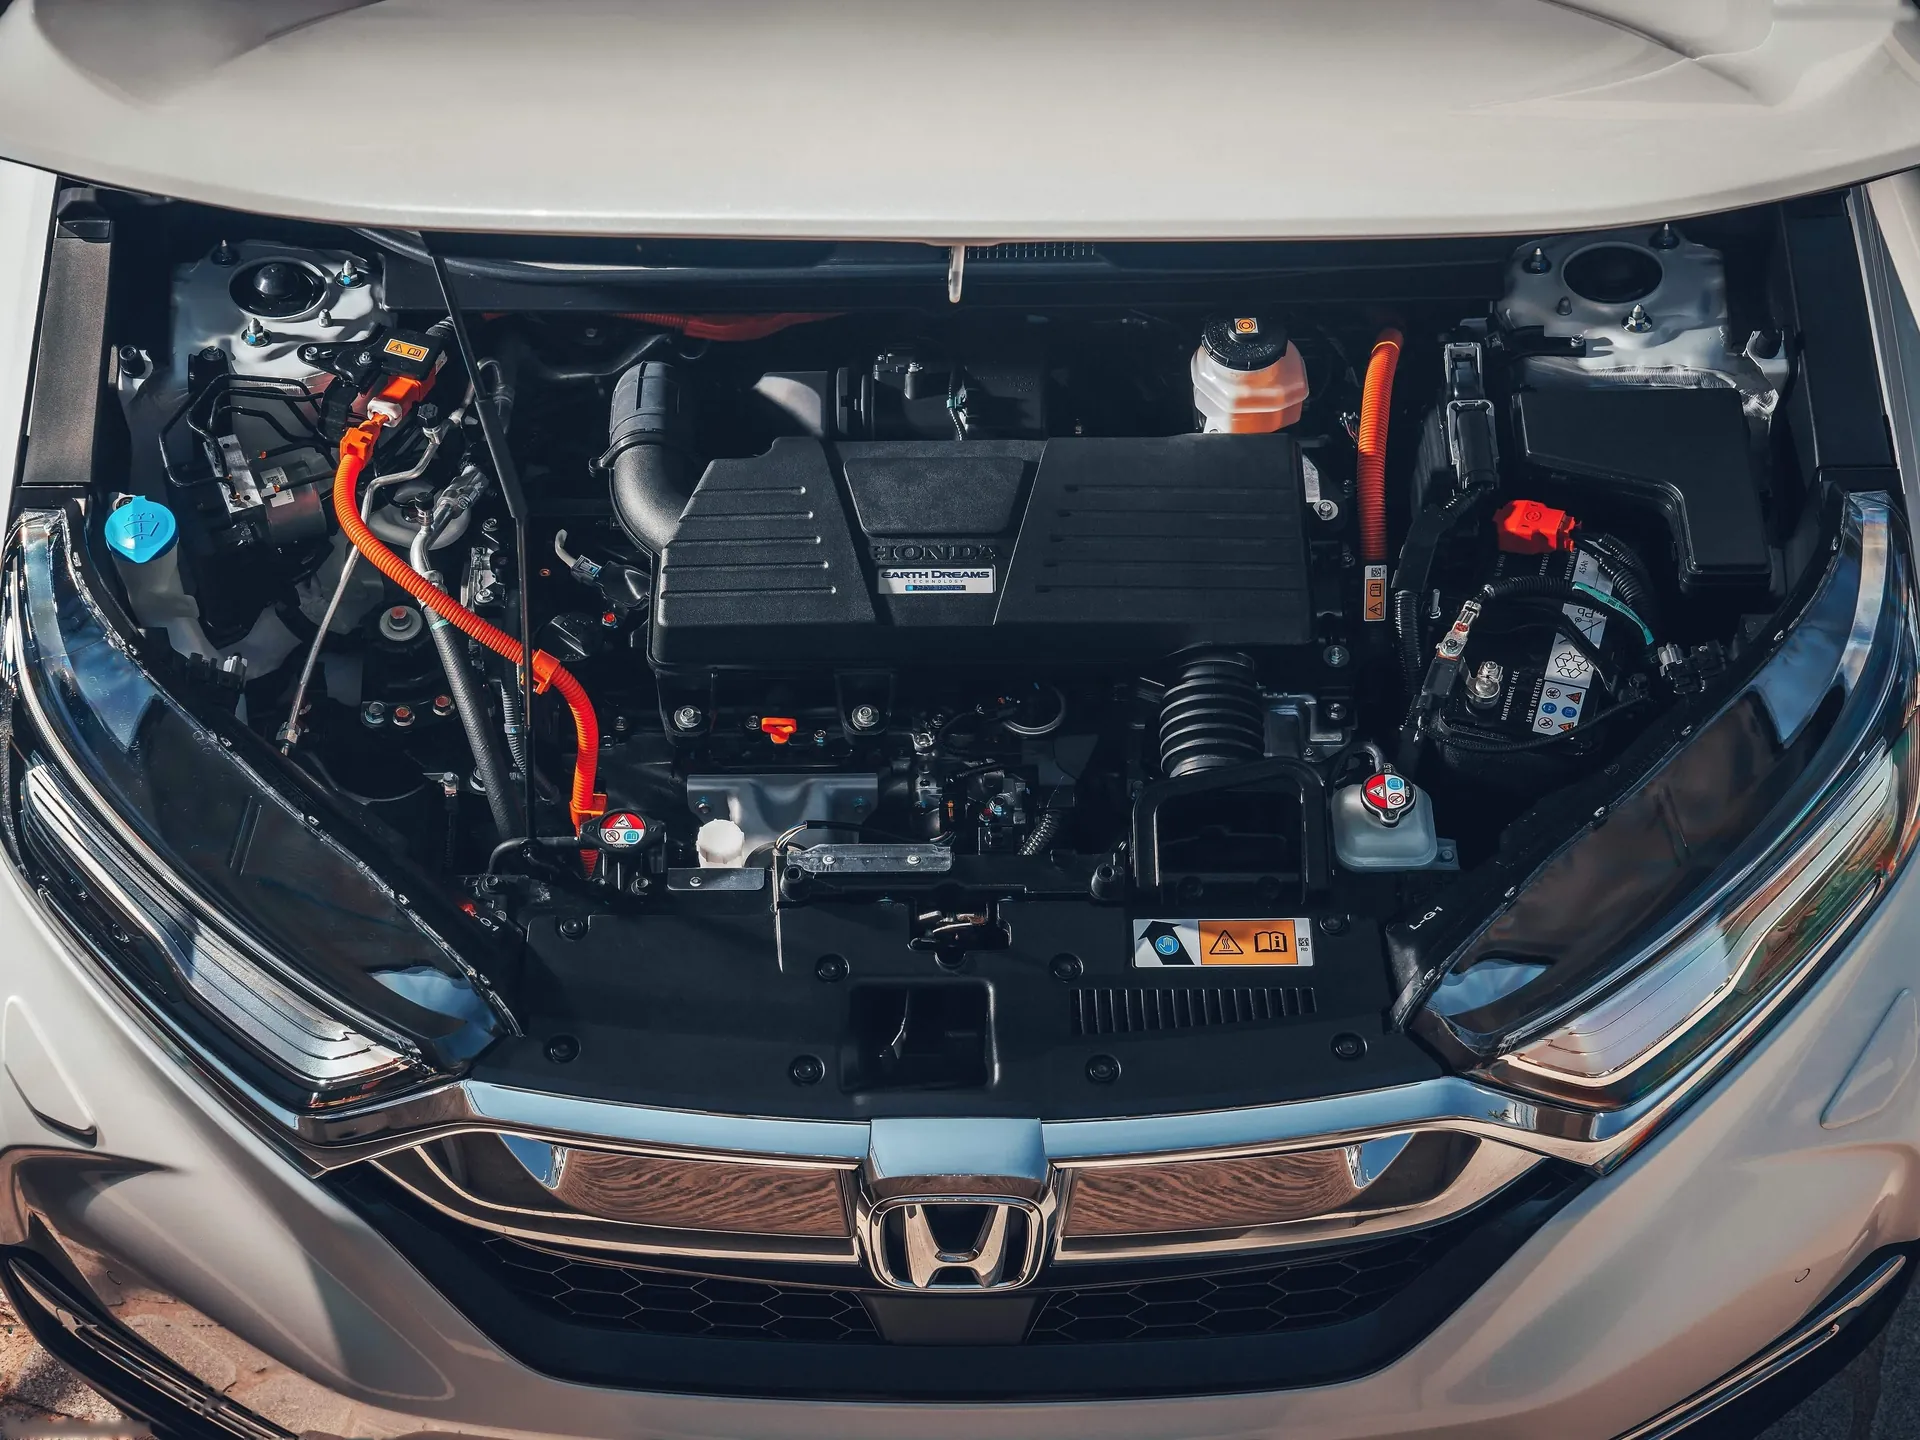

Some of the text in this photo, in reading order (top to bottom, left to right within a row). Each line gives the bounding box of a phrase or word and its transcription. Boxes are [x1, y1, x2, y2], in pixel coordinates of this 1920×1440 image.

[872, 545, 998, 560] HONDA
[881, 570, 990, 579] EARTH DREAMS
[1577, 607, 1594, 619] Pb
[1500, 670, 1521, 721] MAINTENANCE FREE
[1525, 678, 1544, 723] SANS ENTRETIEN
[1408, 906, 1444, 931] L-G1
